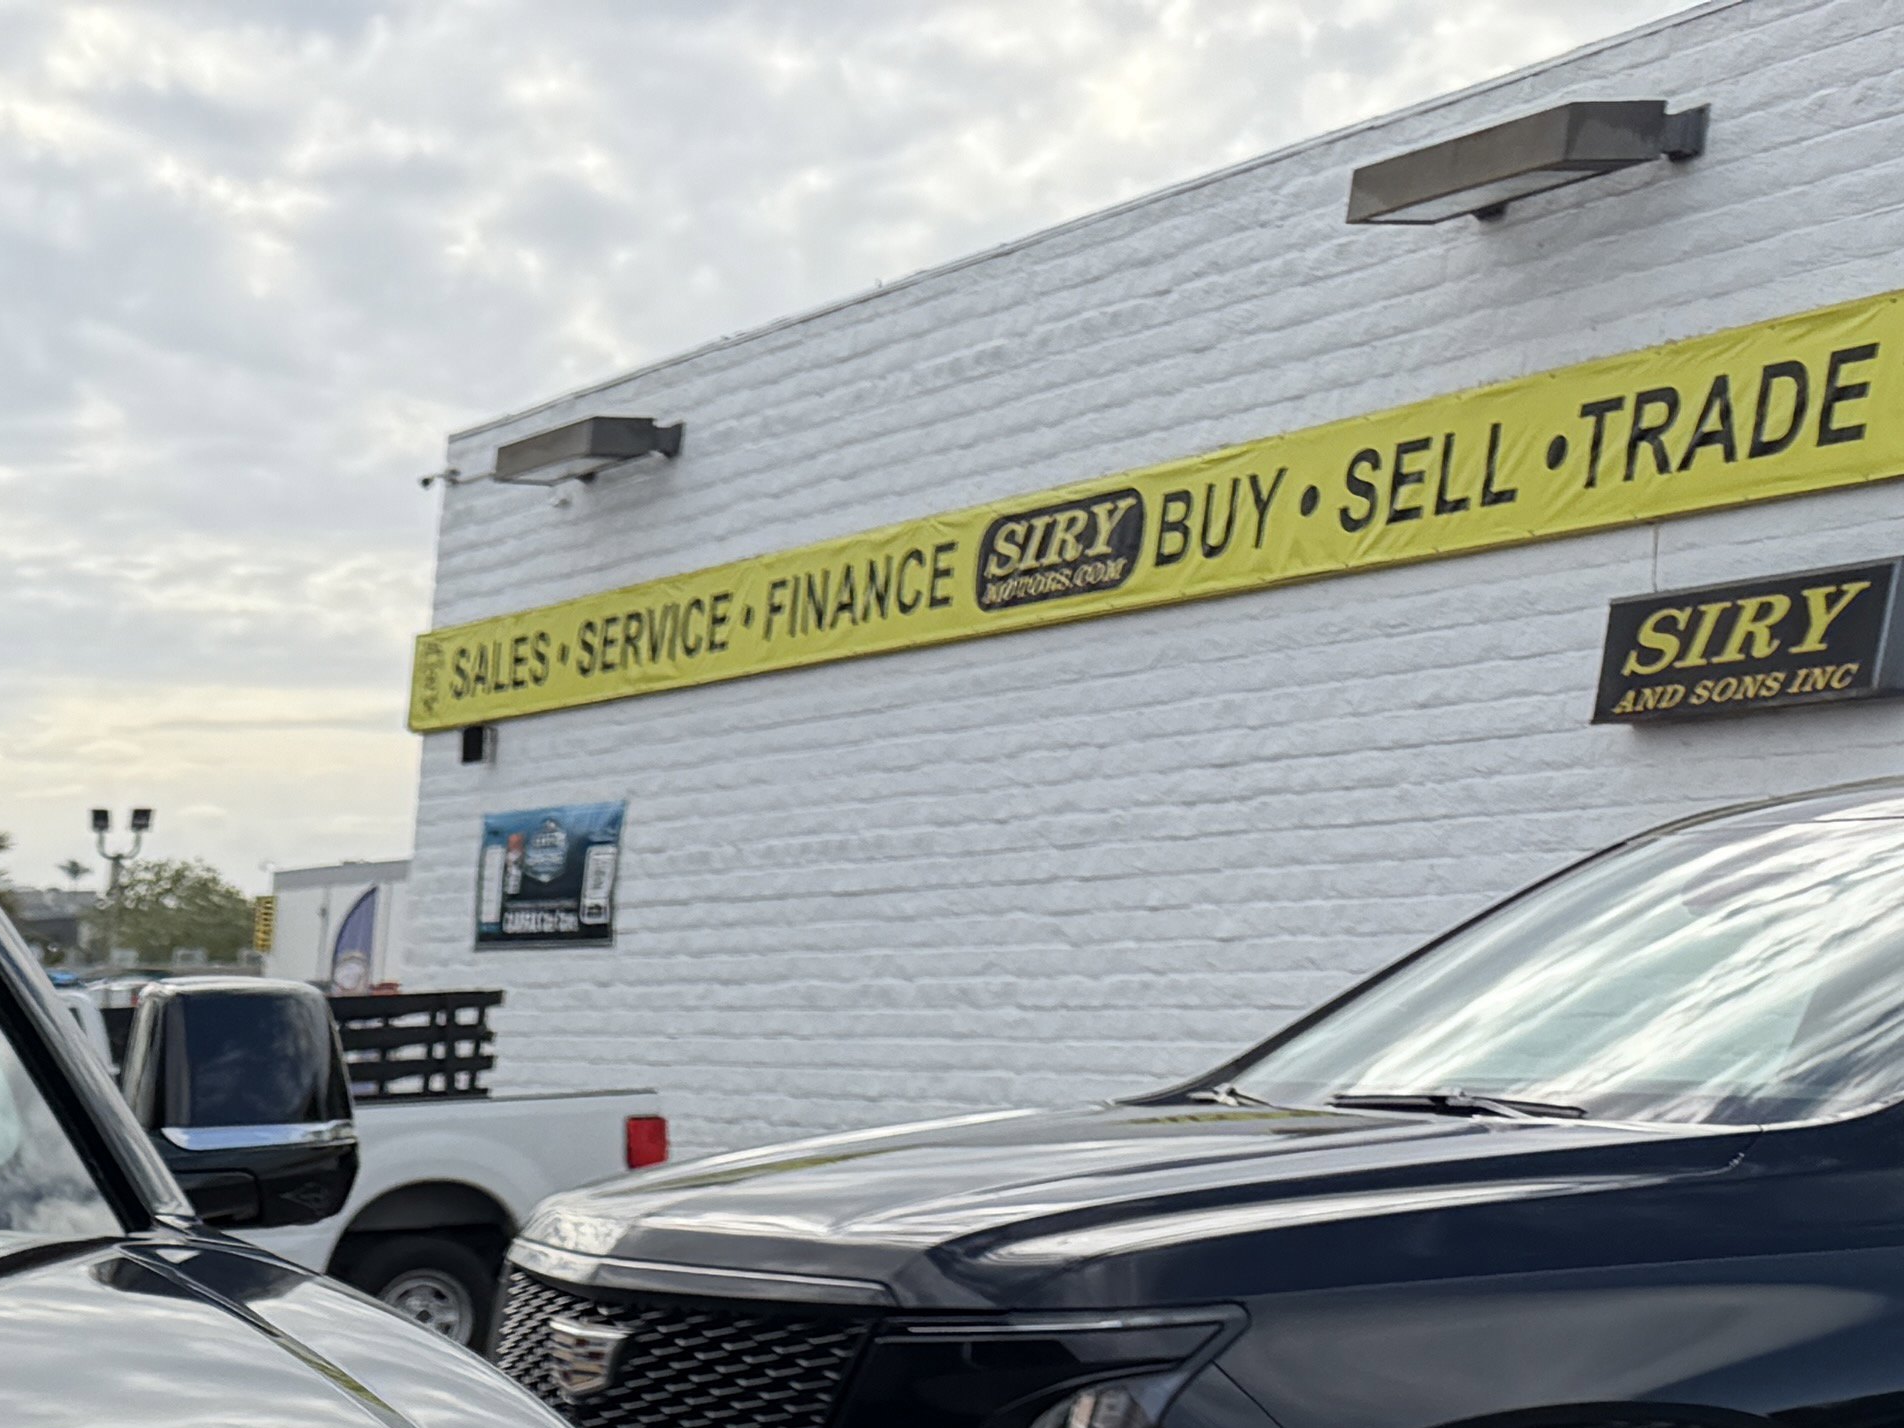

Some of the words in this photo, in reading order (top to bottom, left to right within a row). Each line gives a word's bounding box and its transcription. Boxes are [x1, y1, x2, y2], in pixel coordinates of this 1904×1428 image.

[1153, 466, 1288, 569] BUY
[1337, 421, 1519, 534] SELL
[1578, 340, 1882, 491] TRADE
[983, 496, 1137, 579] SIRY
[450, 630, 551, 699] SALES
[575, 590, 734, 679] SERVICE
[761, 540, 961, 643] FINANCE
[1620, 579, 1872, 679] SIRY
[1611, 681, 1683, 716] AND
[1688, 671, 1785, 705] SONS
[1787, 661, 1861, 695] INC
